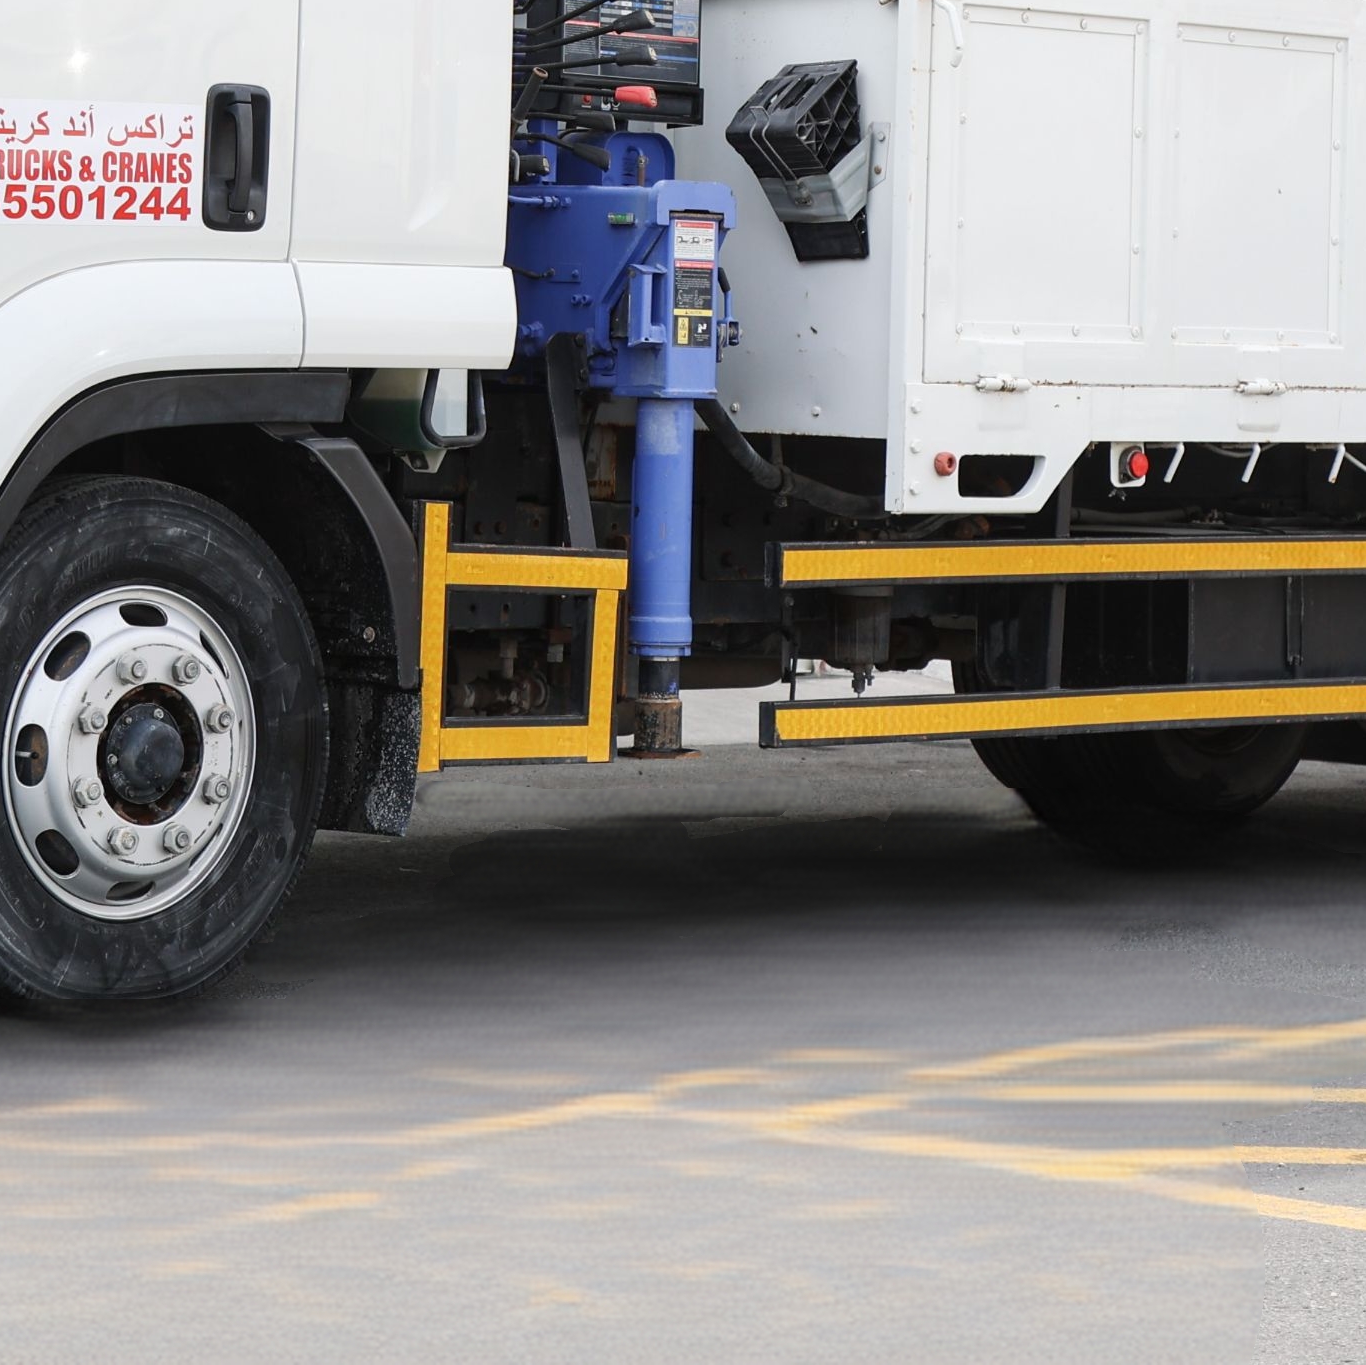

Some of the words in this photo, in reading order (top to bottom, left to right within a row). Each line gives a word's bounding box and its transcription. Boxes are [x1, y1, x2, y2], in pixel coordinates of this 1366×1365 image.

[107, 113, 194, 148] تراكس
[78, 155, 96, 183] &
[102, 151, 193, 184] CRANES
